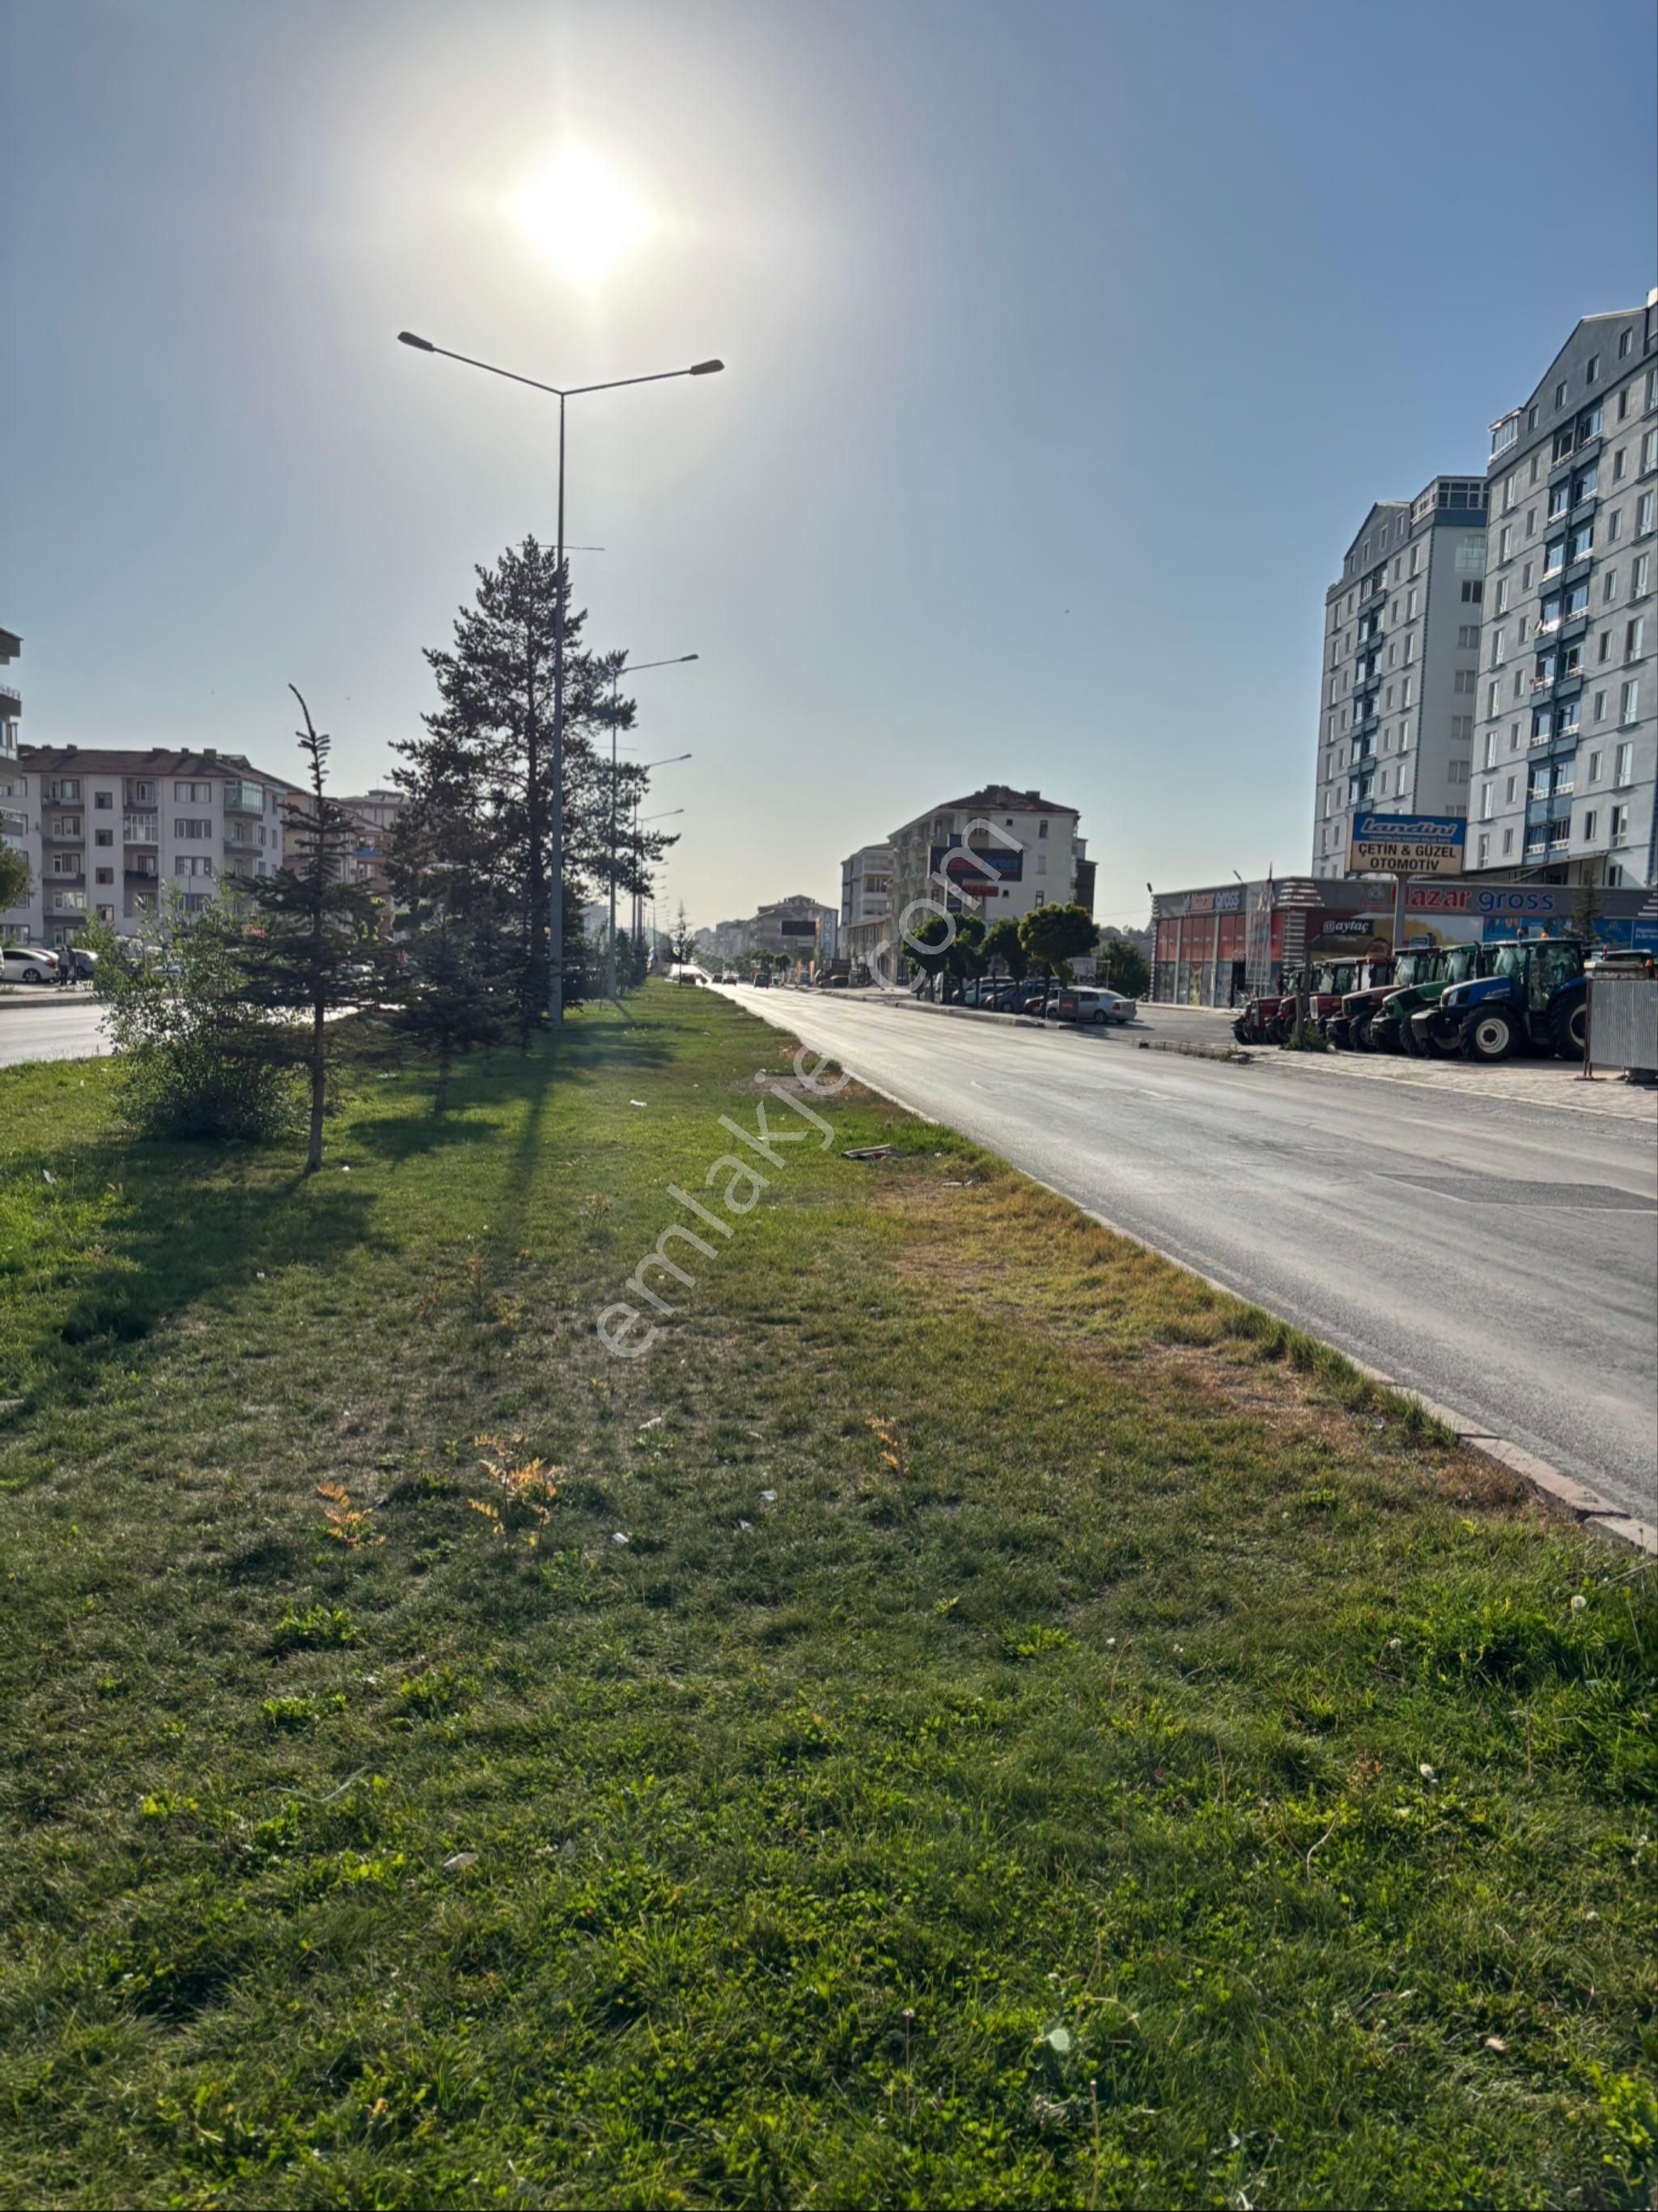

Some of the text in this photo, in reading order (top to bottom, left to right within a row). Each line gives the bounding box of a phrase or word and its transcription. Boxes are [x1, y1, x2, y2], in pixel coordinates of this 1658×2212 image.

[1360, 817, 1458, 837] Landini
[1359, 843, 1457, 858] ÇETİN & GÜZEL
[1370, 857, 1440, 871] OTOMOTİV
[1477, 889, 1555, 912] gross
[1335, 921, 1369, 934] aytaç
